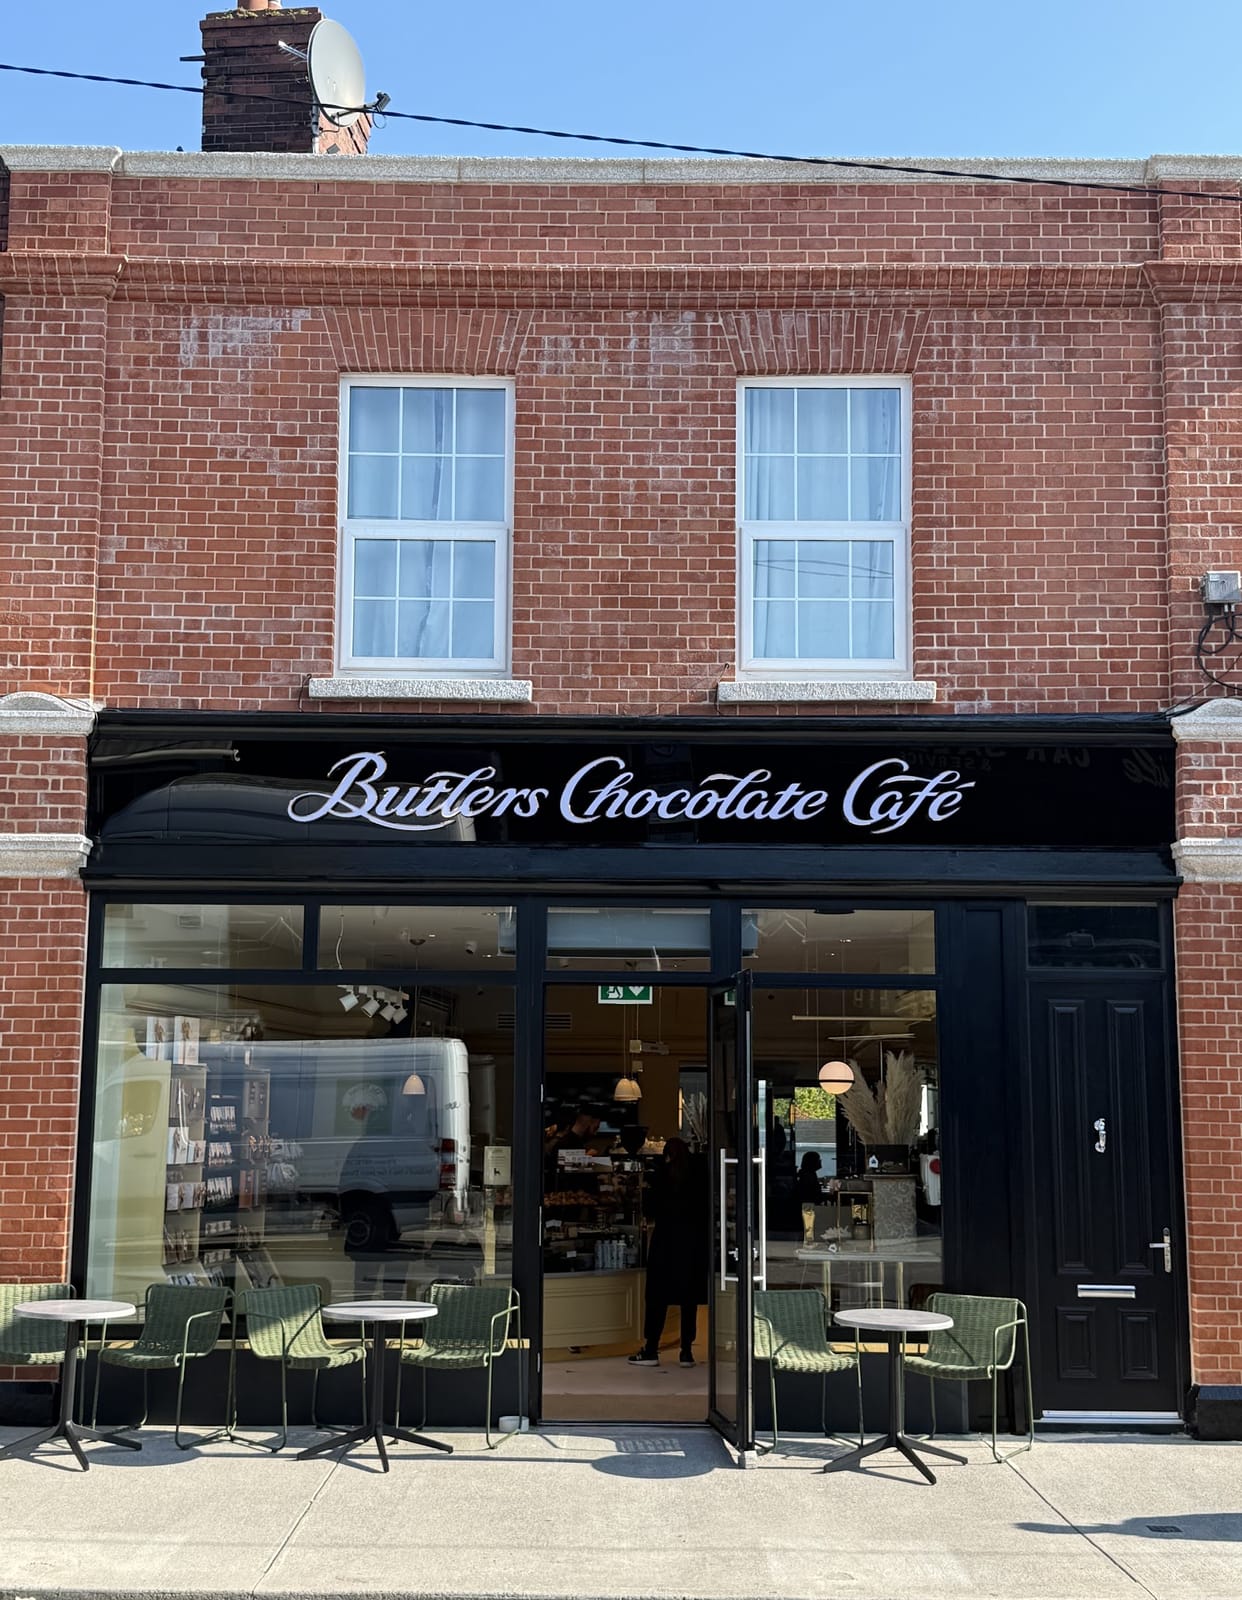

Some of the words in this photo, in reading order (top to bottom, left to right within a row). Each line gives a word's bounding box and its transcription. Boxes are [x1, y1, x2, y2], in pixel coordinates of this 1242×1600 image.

[287, 752, 549, 832] Butlers
[559, 756, 828, 824] Chocolate
[842, 758, 976, 835] Café
